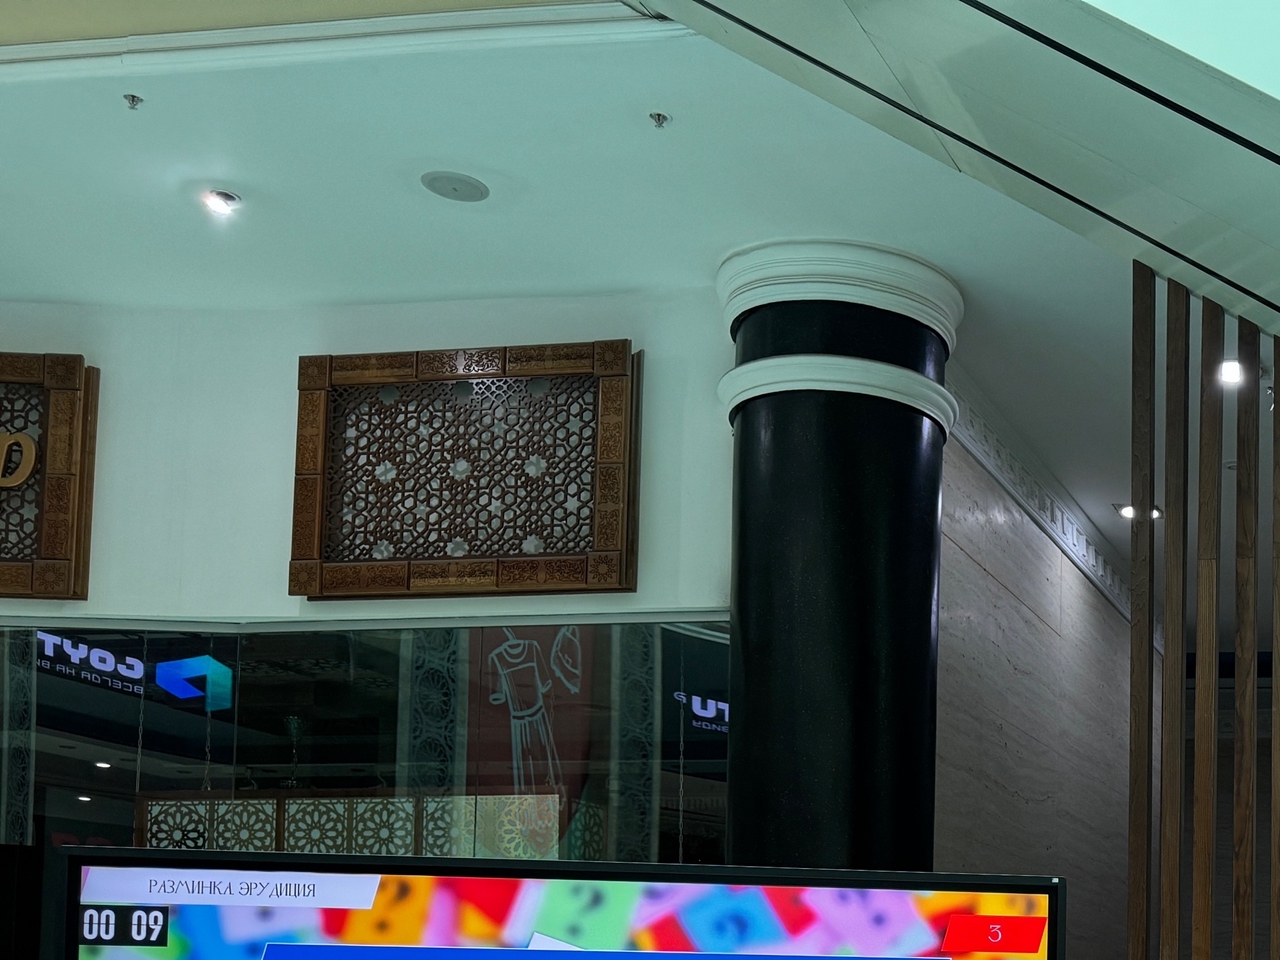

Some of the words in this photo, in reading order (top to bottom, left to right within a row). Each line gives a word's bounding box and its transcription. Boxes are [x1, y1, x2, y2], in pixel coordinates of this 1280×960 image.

[148, 879, 234, 895] РАЗМИНКА
[238, 881, 316, 898] ЭРУДИЦИЯ
[83, 909, 115, 940] 00
[131, 910, 164, 941] 09
[988, 924, 1002, 943] 3
